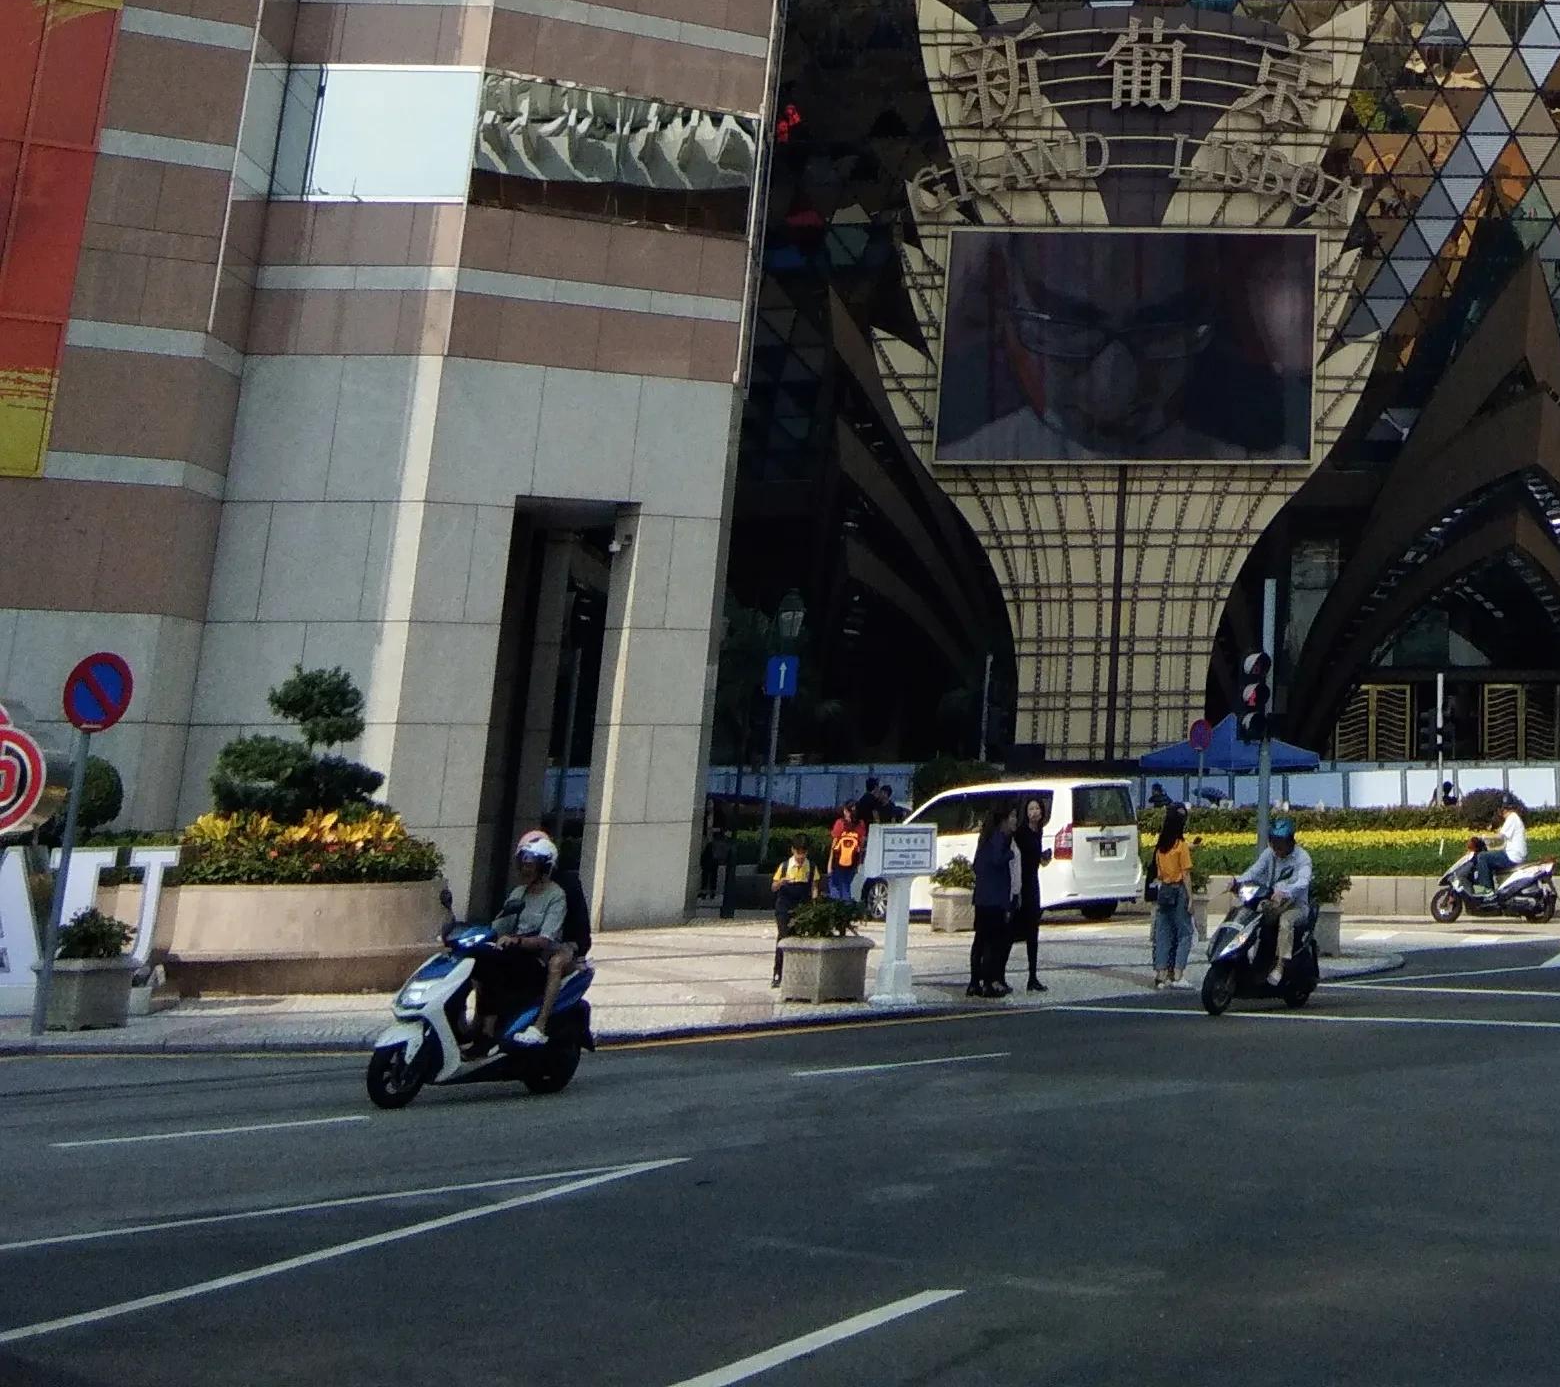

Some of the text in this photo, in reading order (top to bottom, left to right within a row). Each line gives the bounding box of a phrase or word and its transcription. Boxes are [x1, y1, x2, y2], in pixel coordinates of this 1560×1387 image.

[949, 16, 1334, 128] 新葡京
[910, 132, 1353, 223] GRAND LISBOA
